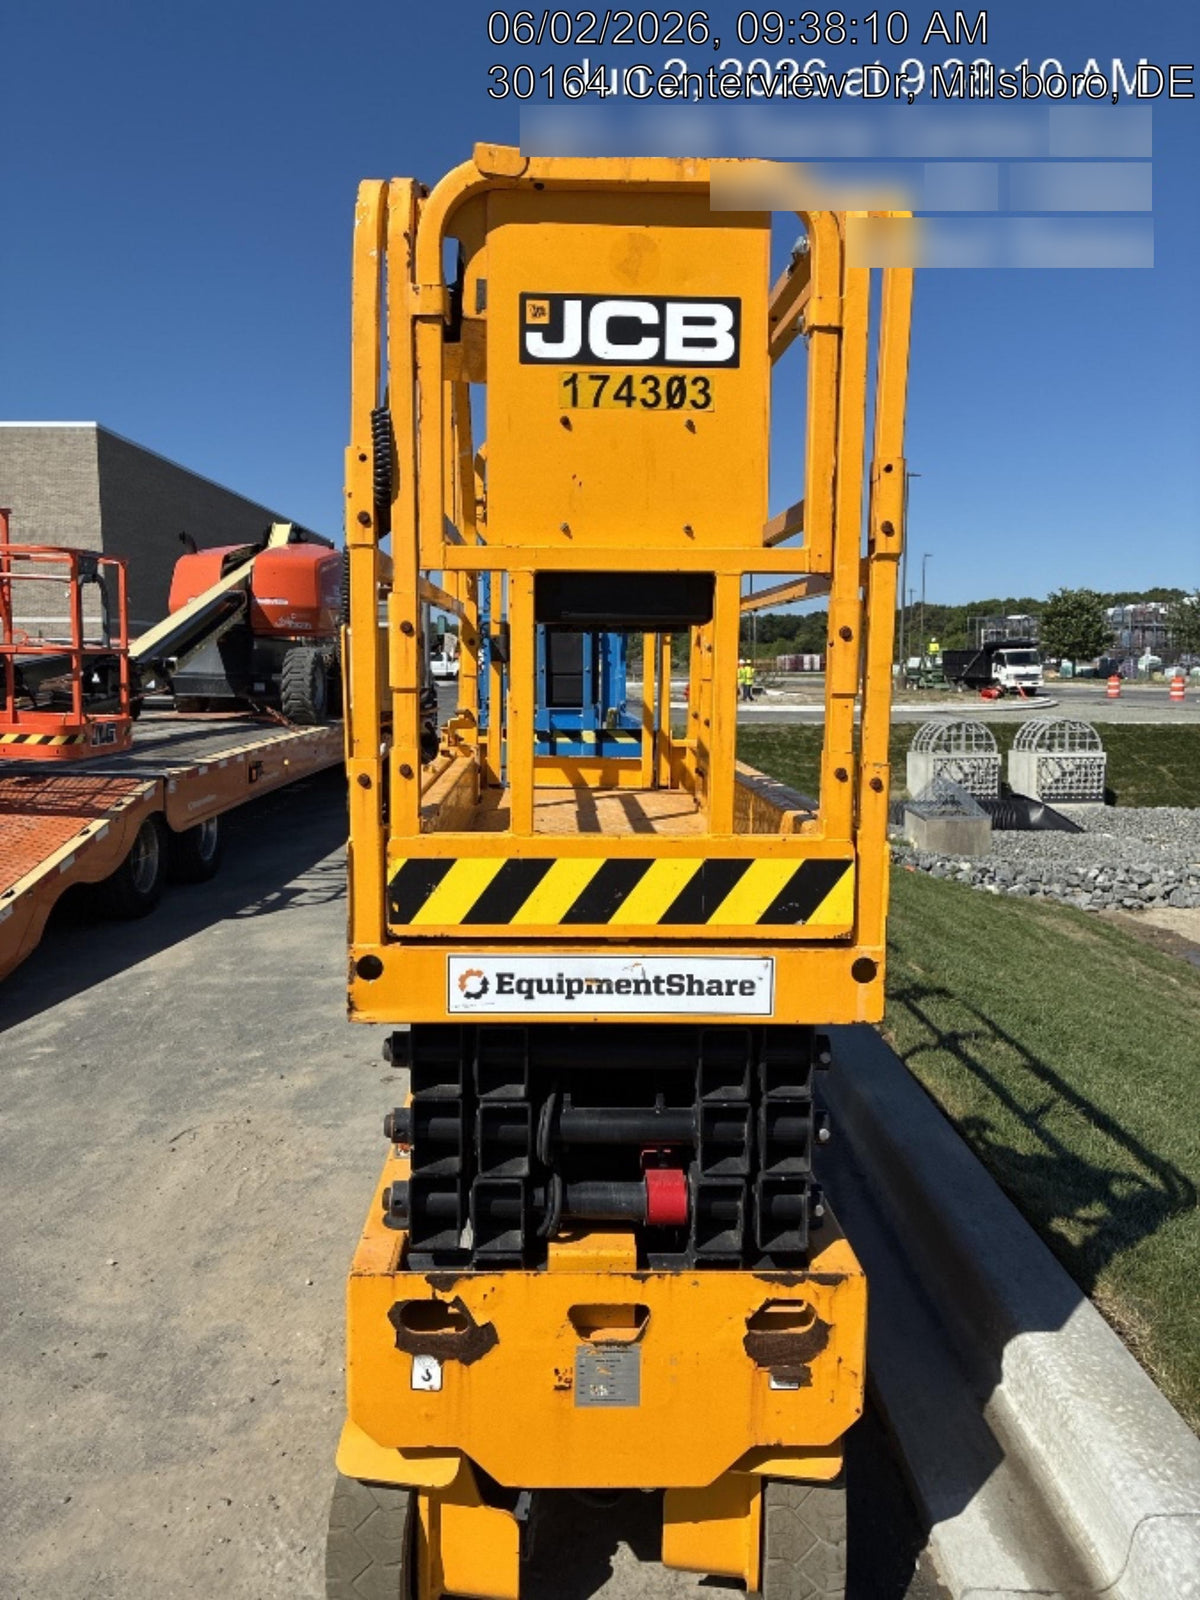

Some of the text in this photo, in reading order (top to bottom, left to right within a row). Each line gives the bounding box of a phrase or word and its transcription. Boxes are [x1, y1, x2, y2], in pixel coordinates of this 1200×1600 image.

[525, 299, 736, 362] JCB
[563, 372, 712, 410] 174303
[496, 972, 756, 1000] EquipmentShare
